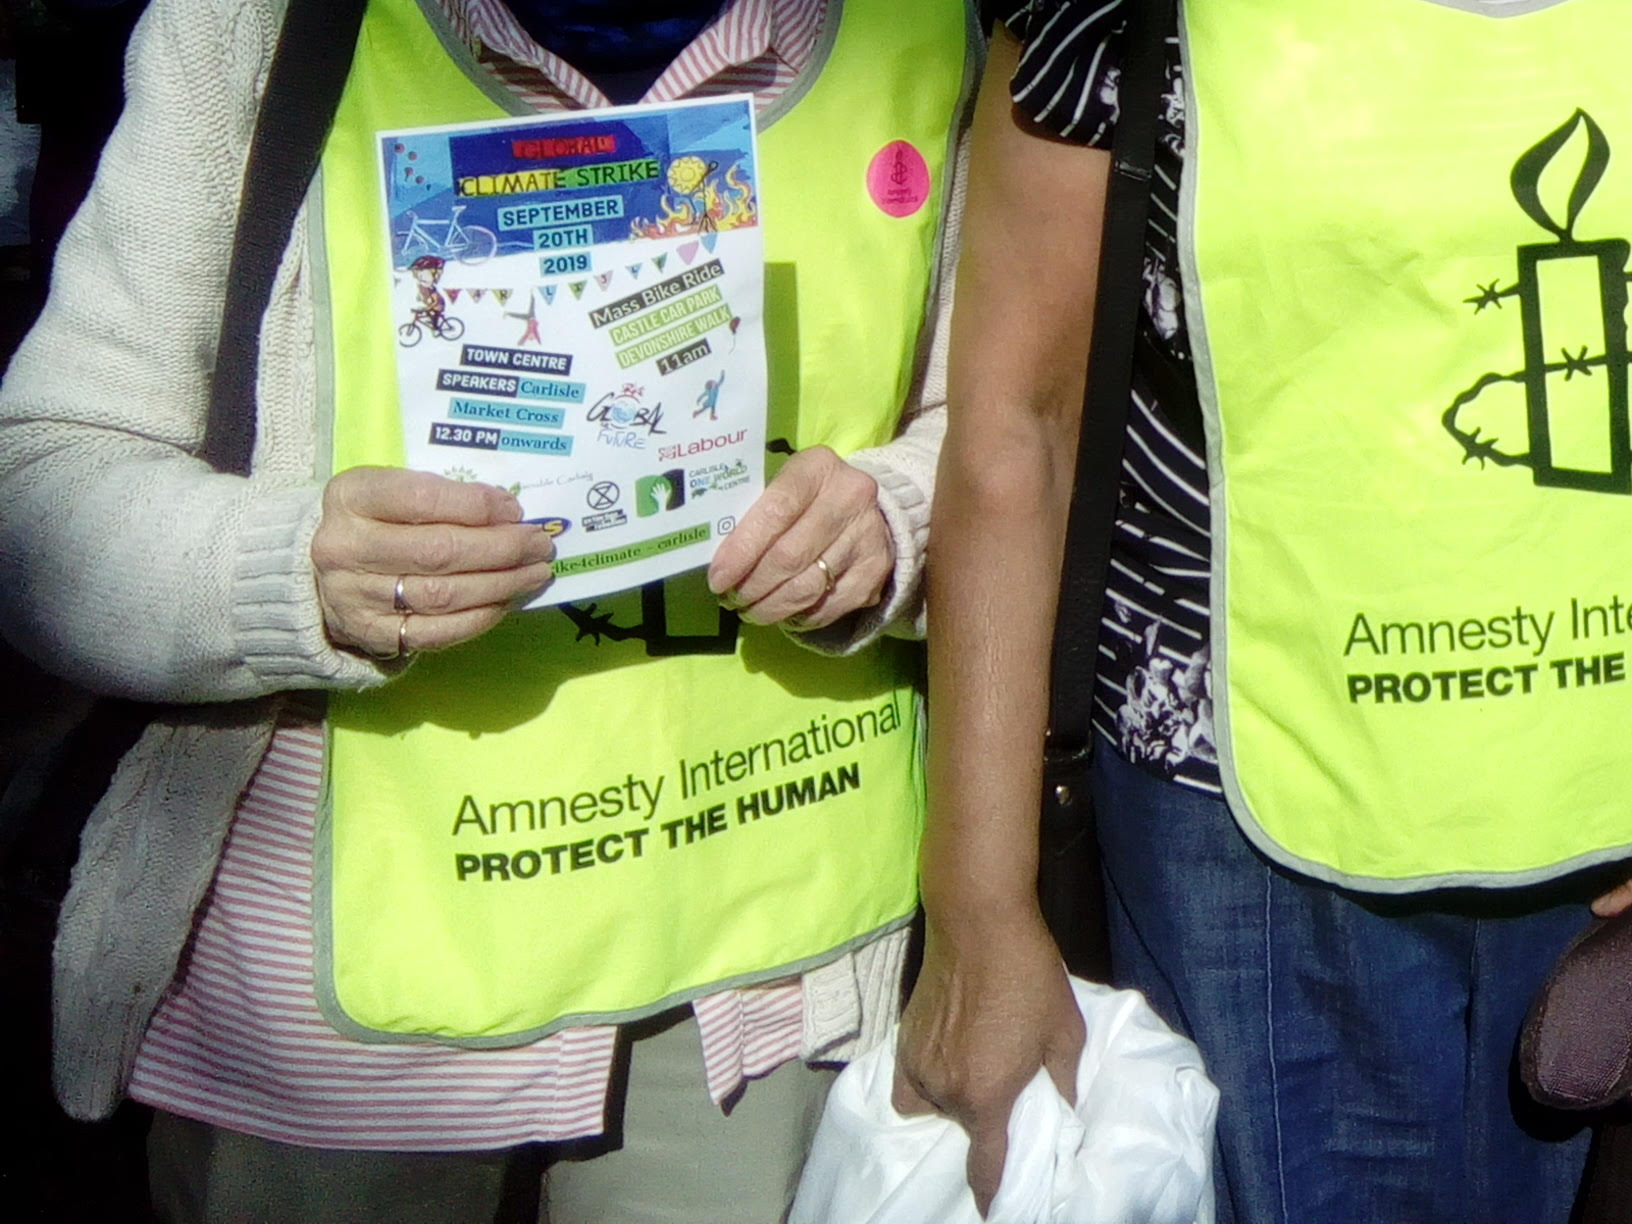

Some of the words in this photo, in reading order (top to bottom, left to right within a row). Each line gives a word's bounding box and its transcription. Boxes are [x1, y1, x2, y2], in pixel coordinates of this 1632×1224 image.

[460, 169, 566, 196] CLIMATE
[576, 160, 660, 188] STRIKE
[503, 199, 618, 226] SEPTEMBER
[538, 228, 588, 248] 20TH
[543, 254, 588, 274] 2019
[591, 298, 640, 327] Mass
[641, 280, 681, 306] Bike
[682, 263, 721, 289] Ride
[611, 317, 660, 345] CASTLE
[660, 302, 687, 323] CAR
[686, 287, 722, 313] PARK
[618, 323, 695, 368] DEVONSHIRE
[694, 306, 730, 333] WALK
[466, 347, 509, 365] TOWN
[512, 355, 567, 371] CENTRE
[660, 344, 709, 374] 11am
[442, 373, 517, 393] SPEAKERS
[520, 380, 579, 399] Carlisle
[453, 401, 511, 420] Market
[516, 407, 560, 423] Cross
[434, 426, 472, 442] 12.30
[475, 430, 498, 445] PM
[501, 434, 567, 451] onwards
[678, 429, 748, 458] Labour
[657, 528, 707, 550] carlisle
[1343, 605, 1556, 658] Amnesty
[1346, 664, 1539, 704] PROTECT
[1549, 652, 1626, 690] THE
[451, 773, 666, 836] Amnesty
[679, 700, 902, 800] International
[455, 827, 650, 882] PROTECT
[659, 803, 728, 849] THE
[736, 762, 862, 825] HUMAN
